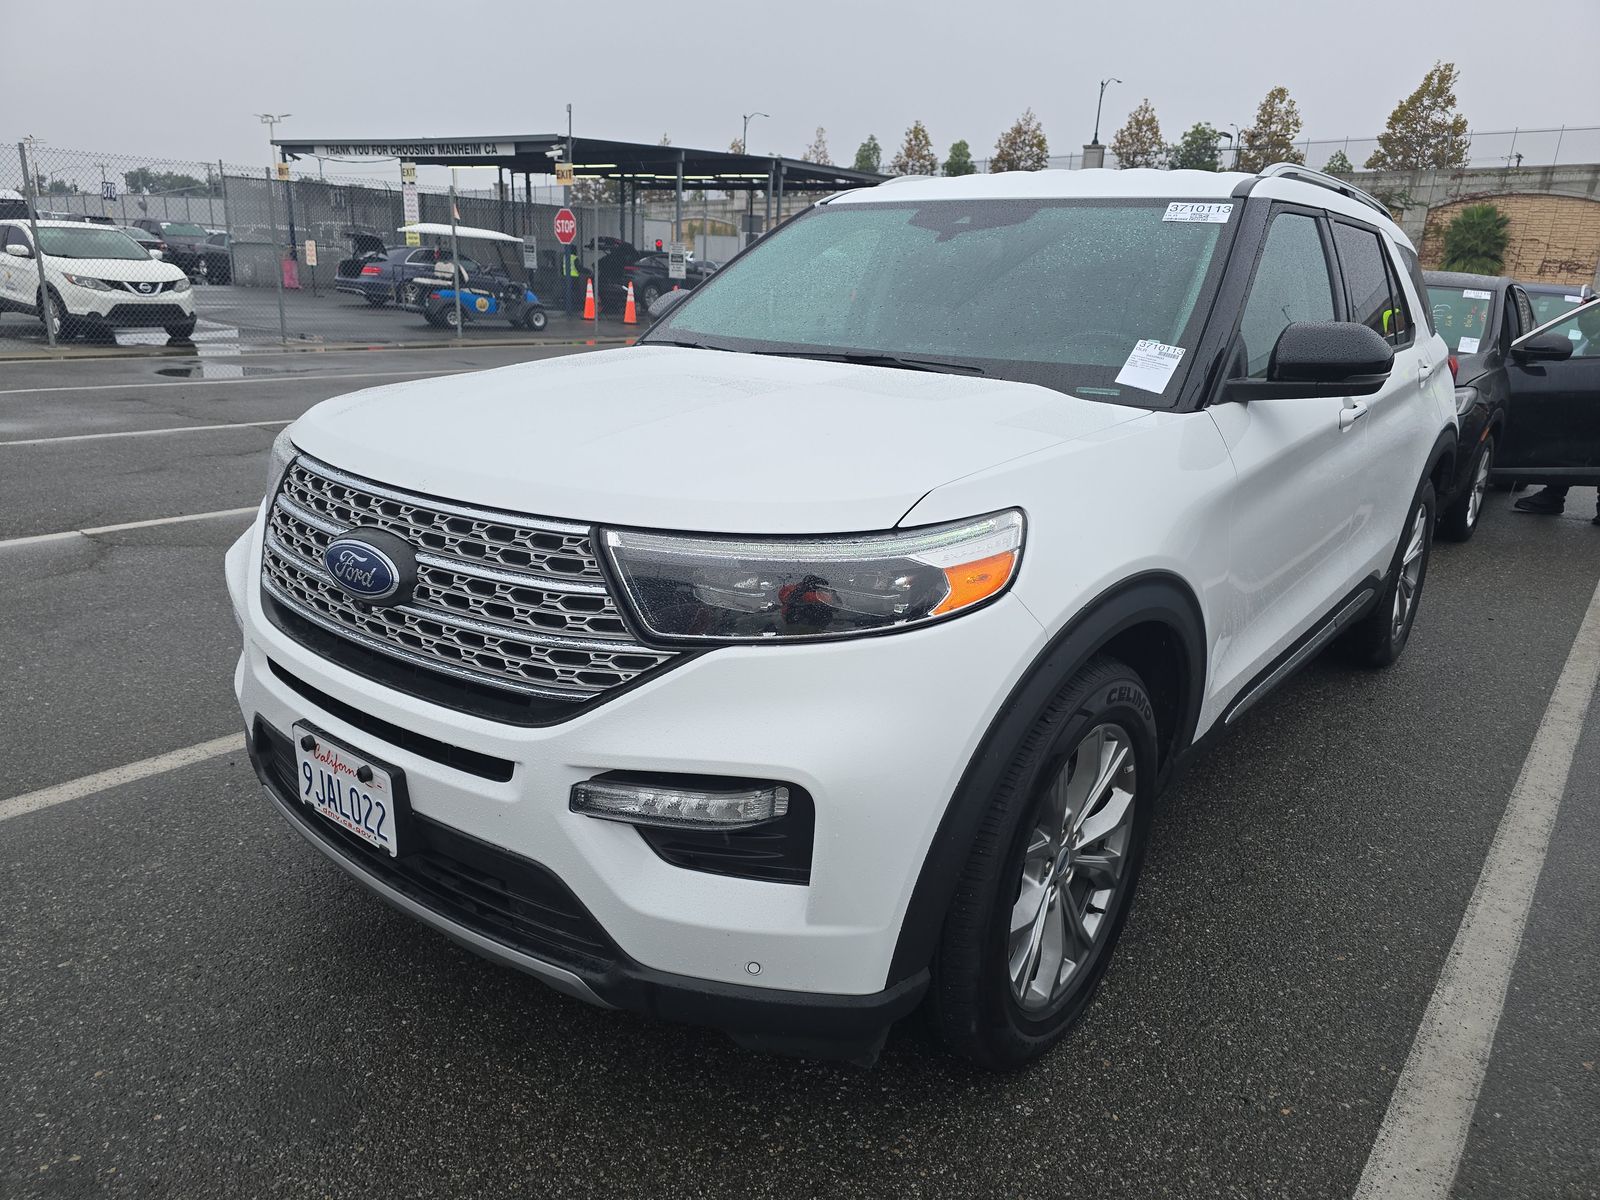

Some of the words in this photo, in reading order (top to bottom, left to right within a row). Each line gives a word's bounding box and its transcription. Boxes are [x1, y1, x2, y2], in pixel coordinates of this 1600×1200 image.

[326, 145, 351, 155] THANK
[352, 145, 370, 155] YOU
[371, 145, 389, 155] FOR
[390, 144, 436, 155] CHOOSING
[437, 143, 482, 155] MANHEIM
[483, 143, 498, 155] CA
[402, 168, 416, 177] EXIT
[556, 169, 573, 180] EXIT
[1169, 204, 1232, 214] 3710113
[556, 219, 575, 234] STOP
[1139, 341, 1185, 355] 3710113
[335, 550, 377, 588] Ford
[313, 742, 370, 785] Californ
[302, 761, 388, 842] 9JAL022
[322, 807, 372, 838] dmv.ca.gov
